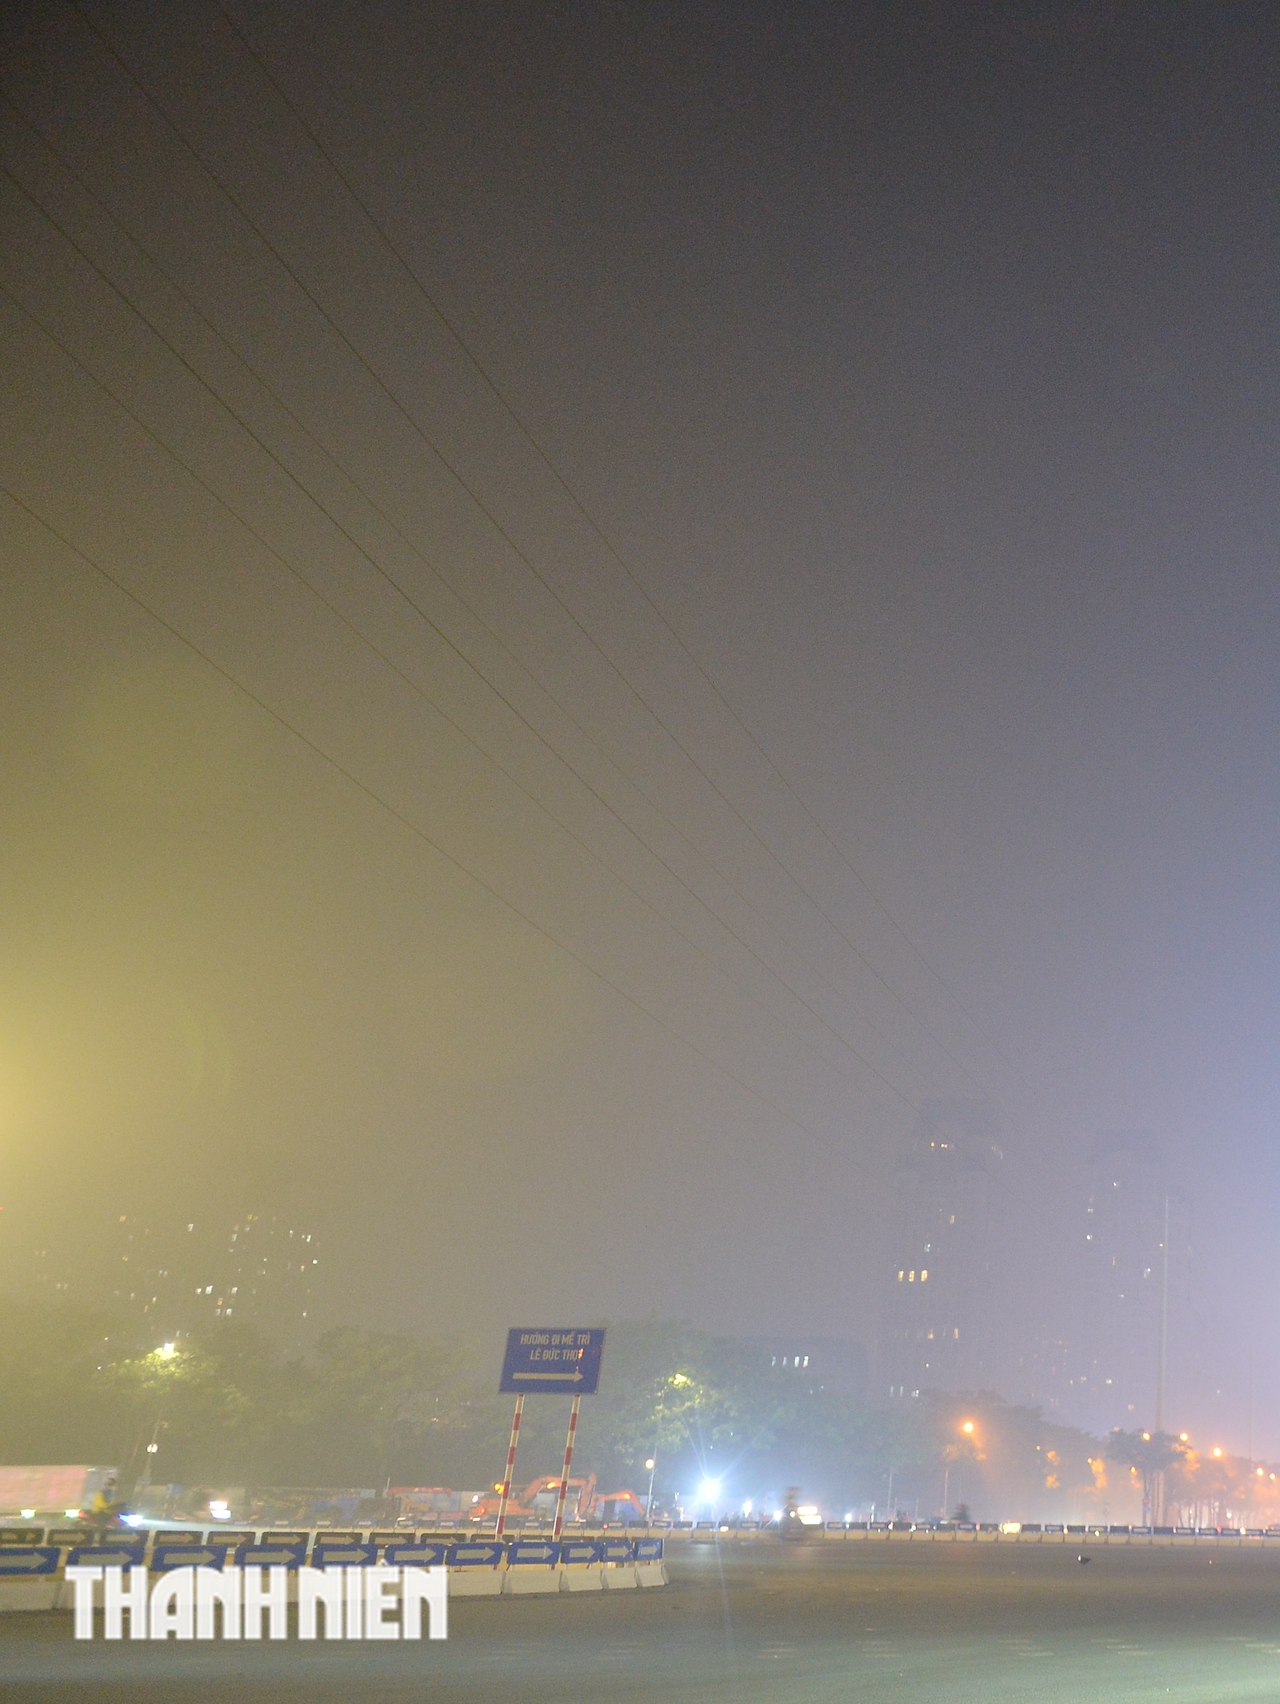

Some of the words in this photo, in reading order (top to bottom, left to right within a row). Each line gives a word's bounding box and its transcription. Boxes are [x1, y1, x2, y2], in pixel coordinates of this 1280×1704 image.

[520, 1332, 549, 1345] HƯỚNG
[551, 1334, 561, 1345] ĐI
[577, 1331, 591, 1345] TRÌ
[530, 1347, 542, 1360] LÊ
[542, 1347, 560, 1360] ĐỨC
